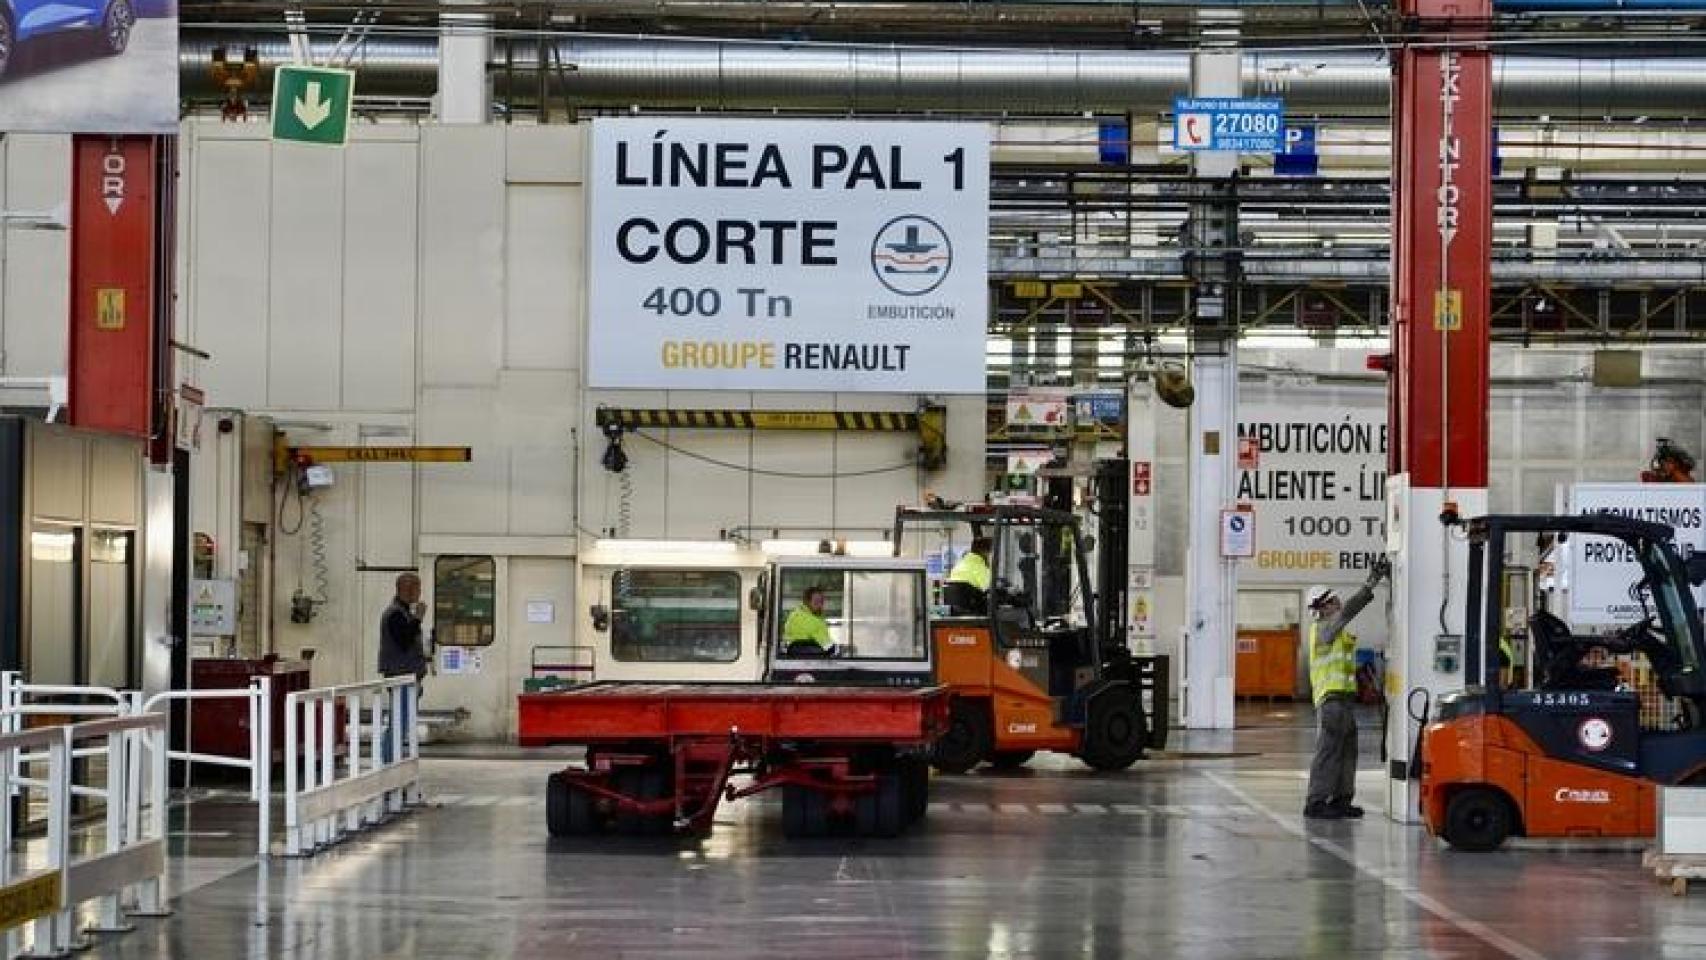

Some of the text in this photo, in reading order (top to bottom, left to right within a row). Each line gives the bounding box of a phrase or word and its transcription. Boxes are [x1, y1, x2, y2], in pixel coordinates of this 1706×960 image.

[1216, 113, 1279, 133] 27080
[1285, 129, 1302, 154] P
[616, 130, 965, 190] LÍNEA PAL 1
[616, 217, 838, 266] CORTE
[642, 287, 792, 318] 400 Tn
[867, 303, 955, 319] EMBUTICIÓN
[662, 341, 910, 371] GROUPE RENAULT
[1237, 470, 1336, 501] ALIENTE
[1284, 515, 1351, 536] 1000
[1257, 550, 1333, 569] GROUPE
